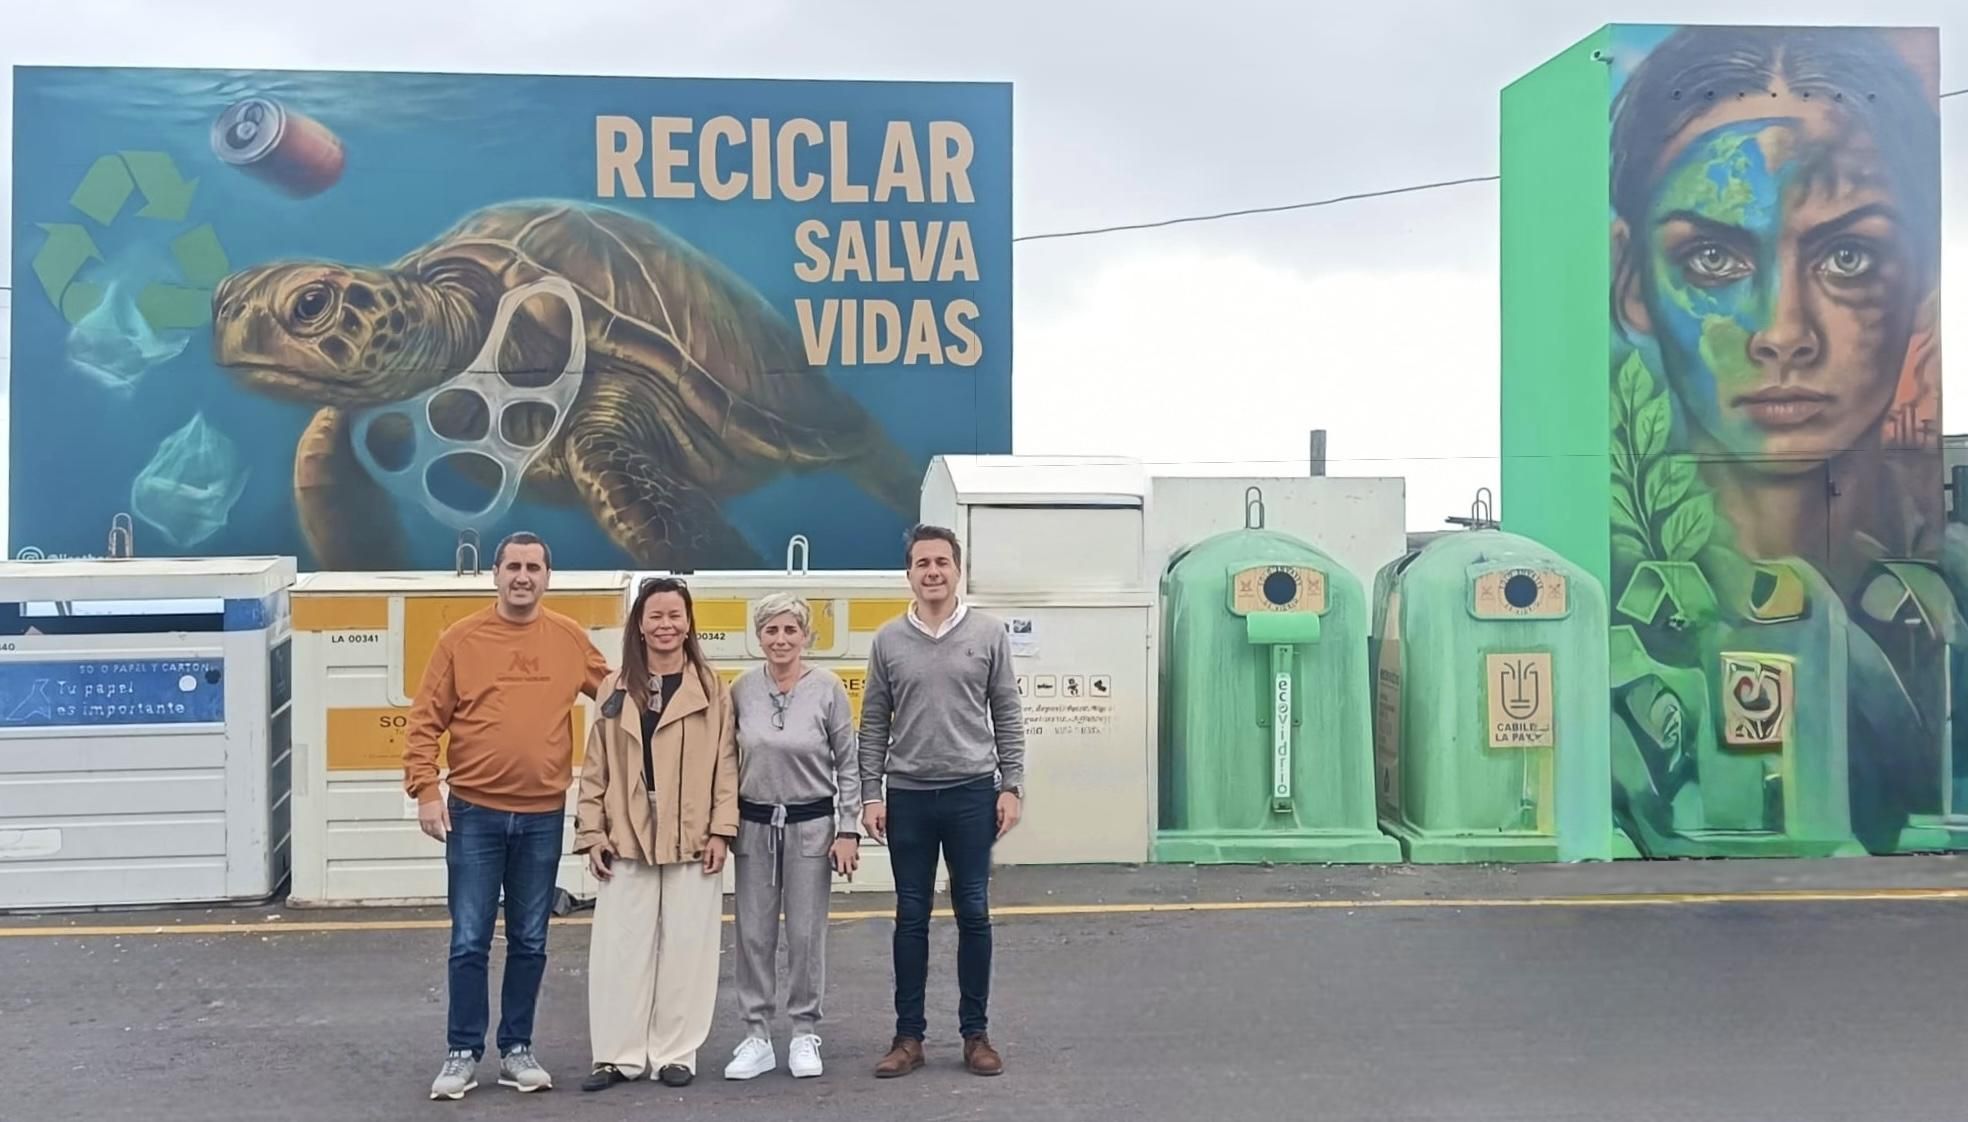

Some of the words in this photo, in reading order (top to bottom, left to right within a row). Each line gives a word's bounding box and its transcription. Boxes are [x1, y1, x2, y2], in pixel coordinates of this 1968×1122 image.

[596, 114, 976, 204] RECICLAR
[793, 219, 980, 283] SALVA
[794, 298, 984, 367] VIDAS
[331, 635, 345, 644] LA
[348, 634, 379, 643] 00341
[113, 664, 146, 673] PAPEL
[152, 663, 158, 672] Y
[57, 681, 76, 695] Tu
[85, 680, 133, 697] papel
[57, 706, 76, 716] es
[82, 702, 185, 718] importante
[1277, 680, 1289, 795] ecovidrio
